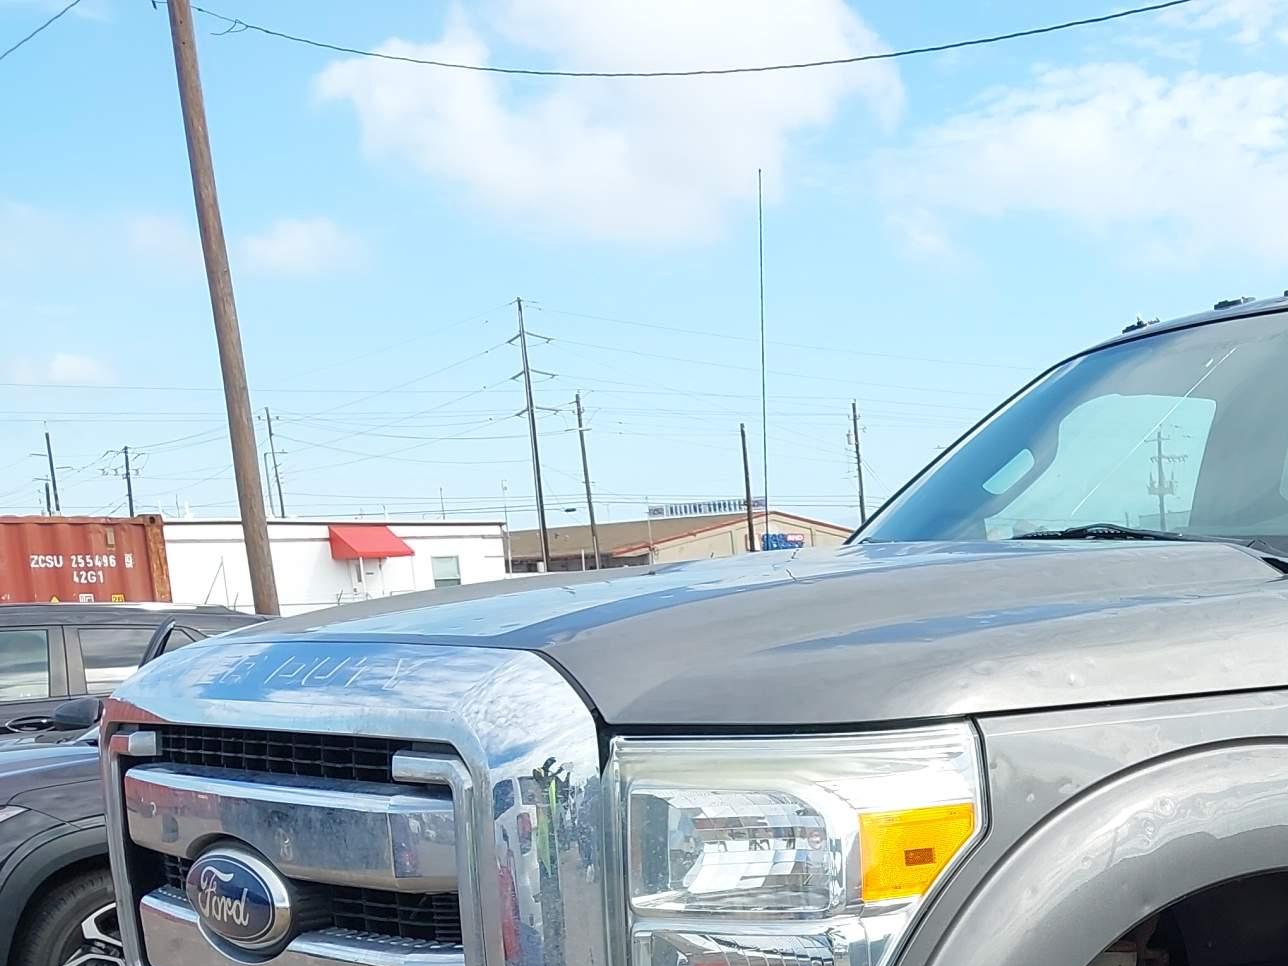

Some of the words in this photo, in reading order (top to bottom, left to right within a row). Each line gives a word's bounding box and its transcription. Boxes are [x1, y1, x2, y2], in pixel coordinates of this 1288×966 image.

[30, 555, 63, 568] ZCSU
[71, 555, 116, 568] 255496
[73, 571, 104, 583] 42G1
[198, 866, 250, 926] Ford
